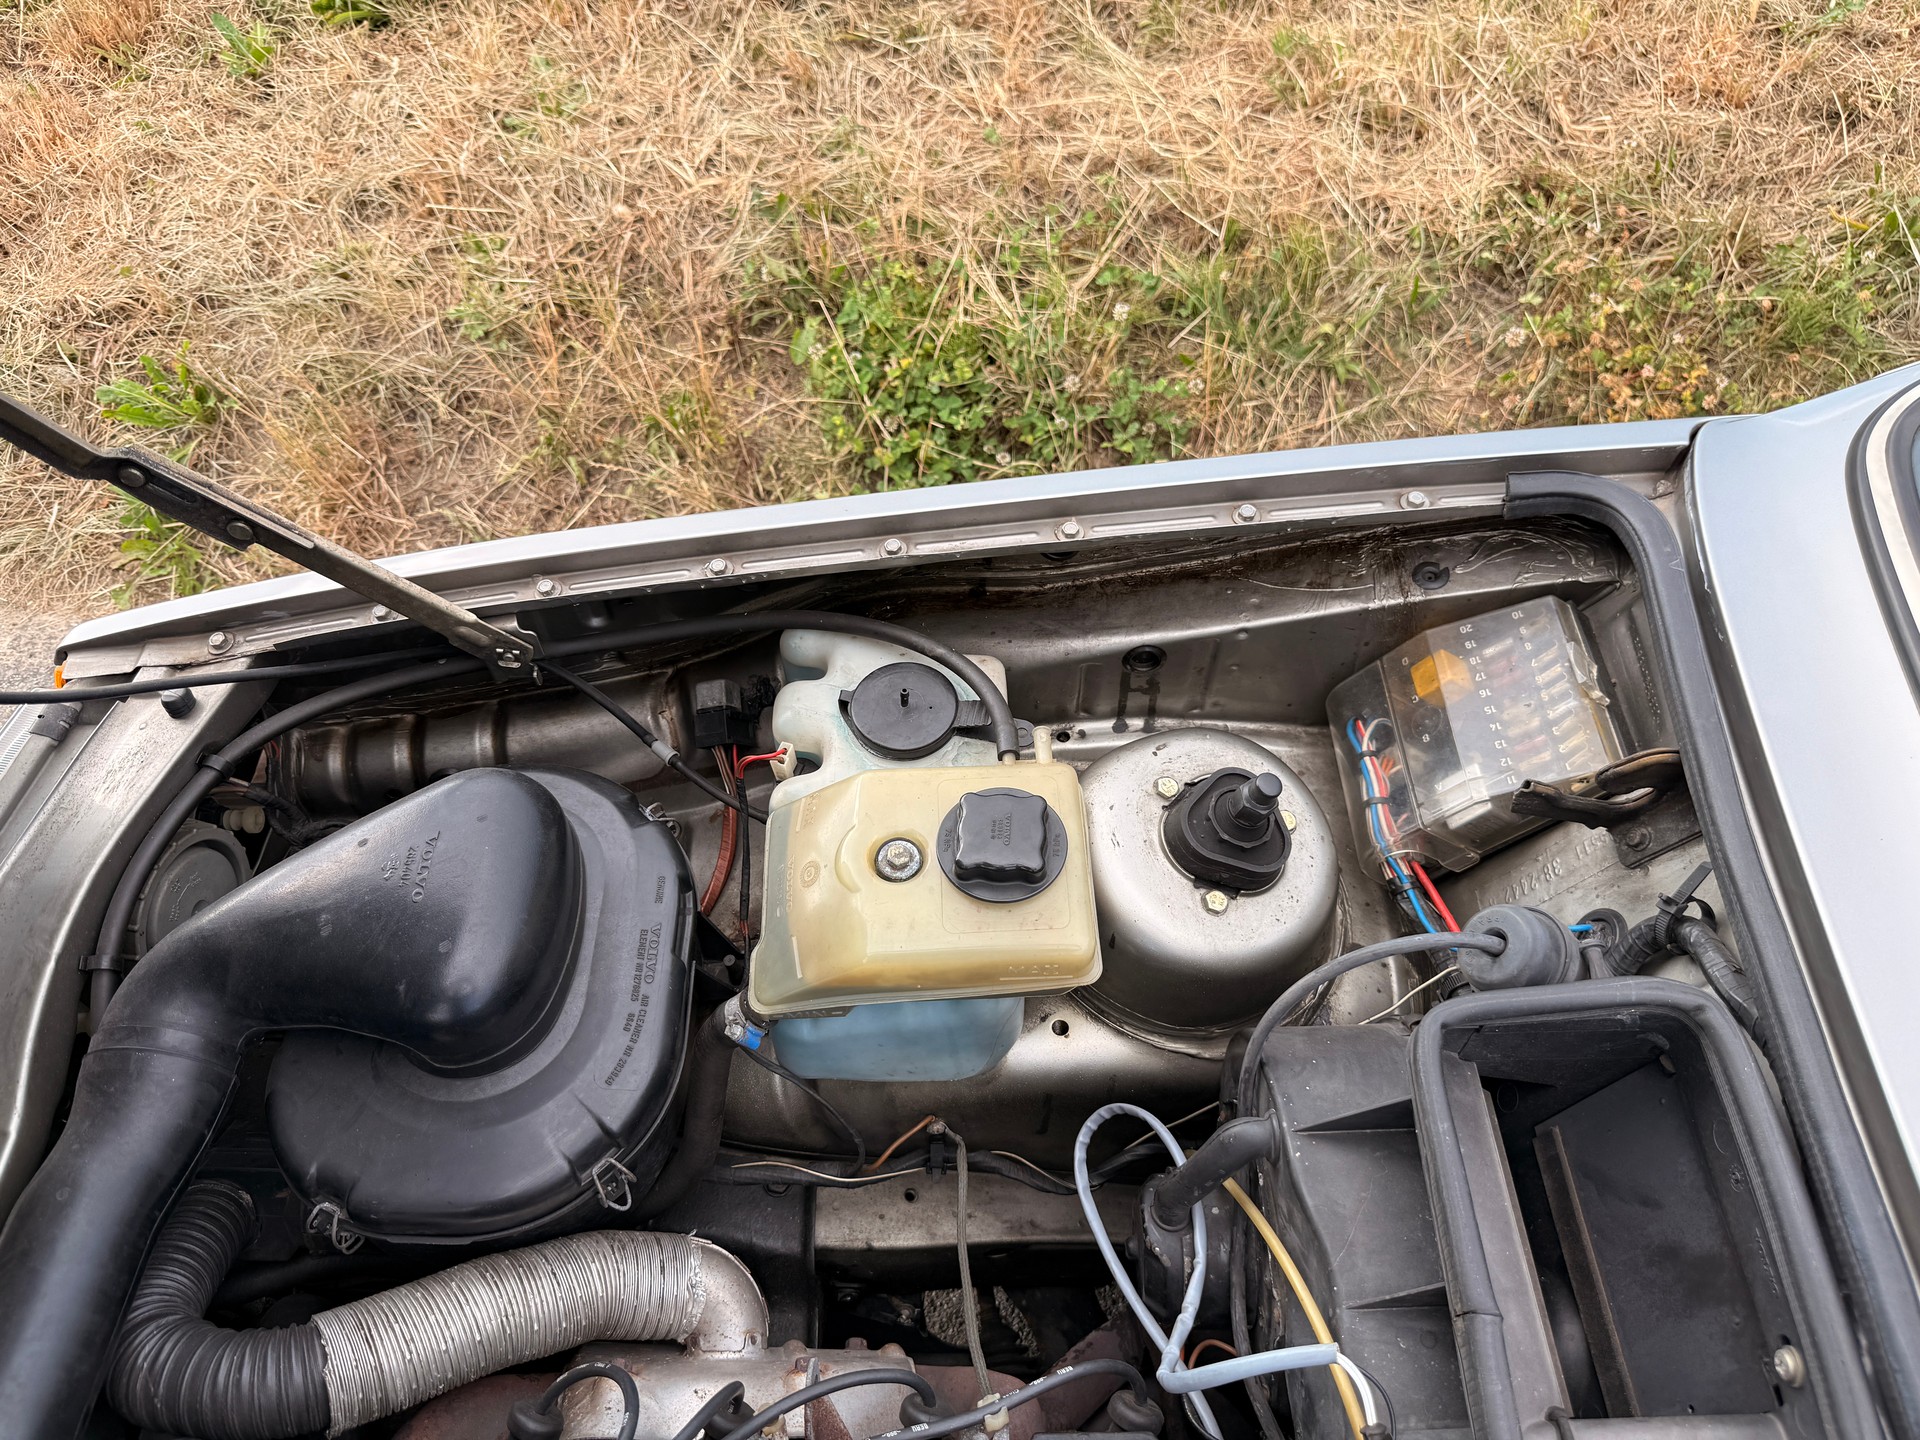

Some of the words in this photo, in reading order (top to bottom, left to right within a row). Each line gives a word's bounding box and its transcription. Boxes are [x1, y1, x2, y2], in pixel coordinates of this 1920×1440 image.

[1511, 610, 1524, 620] 10
[1459, 624, 1473, 634] 20
[1519, 626, 1527, 635] 9
[1464, 640, 1478, 649] 19
[1469, 655, 1482, 665] 18
[1475, 672, 1487, 682] 17
[1478, 688, 1492, 698] 16
[1483, 705, 1497, 715] 15
[1489, 721, 1502, 732] 14
[1494, 739, 1508, 749] 13
[1499, 757, 1513, 767] 12
[1506, 775, 1518, 785] 11
[1003, 812, 1012, 846] VOLVO
[412, 830, 441, 904] VOLVO
[636, 928, 649, 961] ELEMENT
[643, 922, 662, 985] VOLVO
[640, 993, 650, 1008] AIR
[629, 1008, 648, 1044] CLEANER
